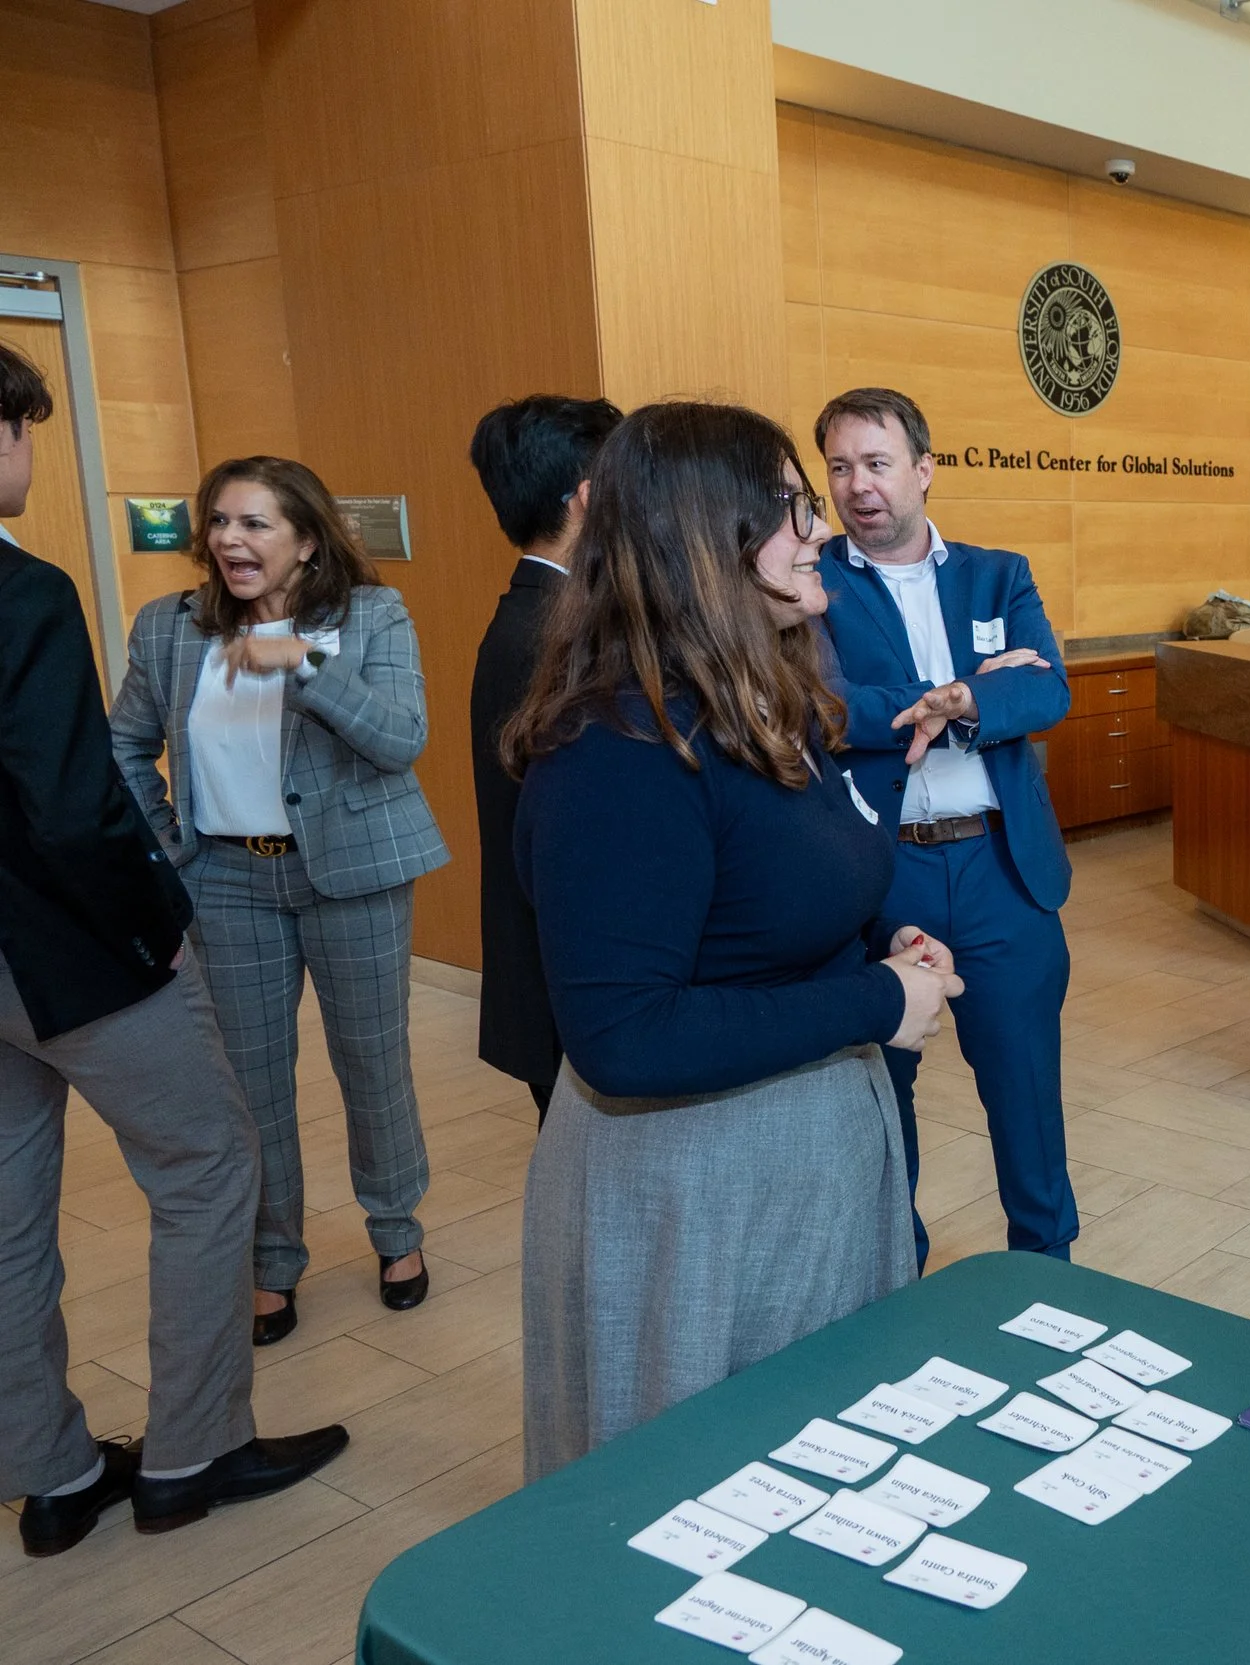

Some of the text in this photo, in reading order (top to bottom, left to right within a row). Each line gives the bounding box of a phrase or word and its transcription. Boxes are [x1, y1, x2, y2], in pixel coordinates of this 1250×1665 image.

[1023, 266, 1119, 399] UNIVERSITY of SOUTH FLORIDA
[1060, 390, 1090, 411] 1956
[964, 446, 983, 467] C.
[988, 448, 1031, 470] Patel
[1037, 450, 1092, 472] Center
[1097, 454, 1117, 473] for
[1122, 454, 1168, 475] Global
[1172, 457, 1234, 478] Solutions
[147, 532, 178, 540] CATERING
[1029, 1317, 1084, 1339] Jean Vaccaro
[952, 1383, 979, 1399] Logan
[1099, 1391, 1124, 1407] Alexis
[872, 1400, 934, 1427] Patrick Walsh
[1147, 1410, 1174, 1426] Floyd
[1008, 1411, 1074, 1442] Sean Schrader
[1175, 1421, 1198, 1435] King
[798, 1439, 870, 1469] Yasuharu Okuda
[1100, 1439, 1126, 1453] Faust
[1124, 1448, 1173, 1472] Jean-Charles
[749, 1475, 776, 1494] Perez
[891, 1478, 921, 1495] Rubin
[1061, 1472, 1085, 1487] Cook
[776, 1488, 806, 1506] Sierra
[921, 1490, 963, 1511] Anjelica
[1086, 1484, 1111, 1500] Sally
[671, 1514, 702, 1533] Nelson
[824, 1511, 901, 1548] Shawn Lenihan
[702, 1528, 747, 1552] Elizabeth
[921, 1558, 998, 1591] Sandra Cantu
[688, 1596, 725, 1615] Hagner
[724, 1608, 773, 1633] Catherine
[790, 1639, 832, 1661] Aguilar
